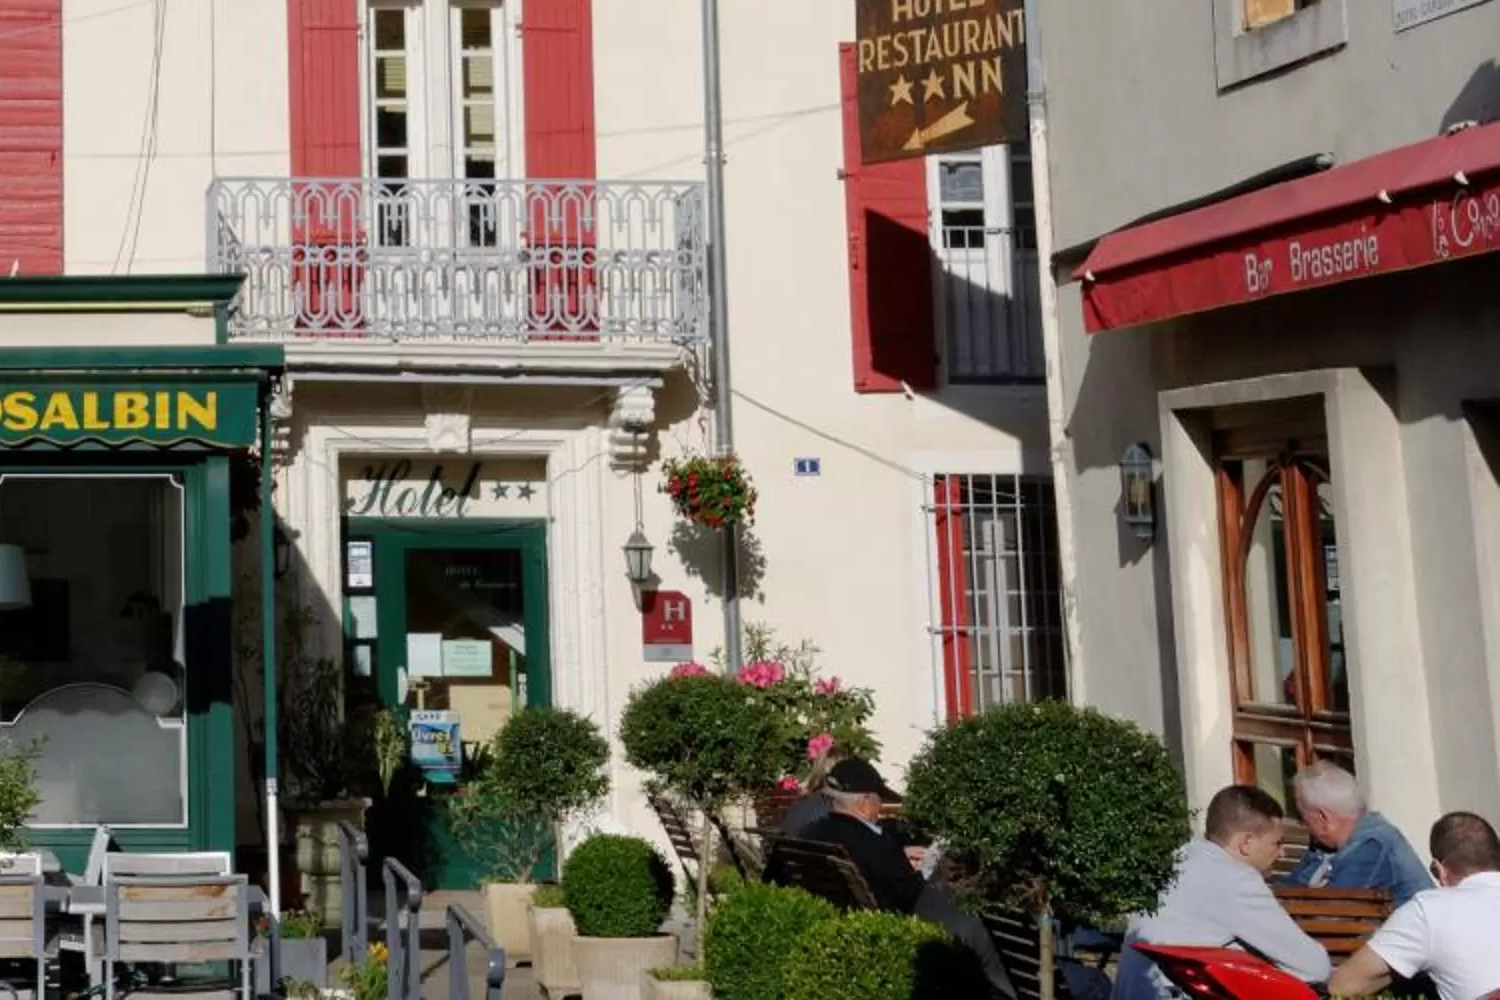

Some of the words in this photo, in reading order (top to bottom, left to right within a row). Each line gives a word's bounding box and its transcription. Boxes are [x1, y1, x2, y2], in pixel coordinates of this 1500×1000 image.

[859, 8, 1026, 73] RESTAURANT
[1245, 253, 1273, 292] Bar
[1290, 225, 1379, 280] Brasserie
[343, 458, 484, 517] Hotel
[663, 600, 686, 621] H
